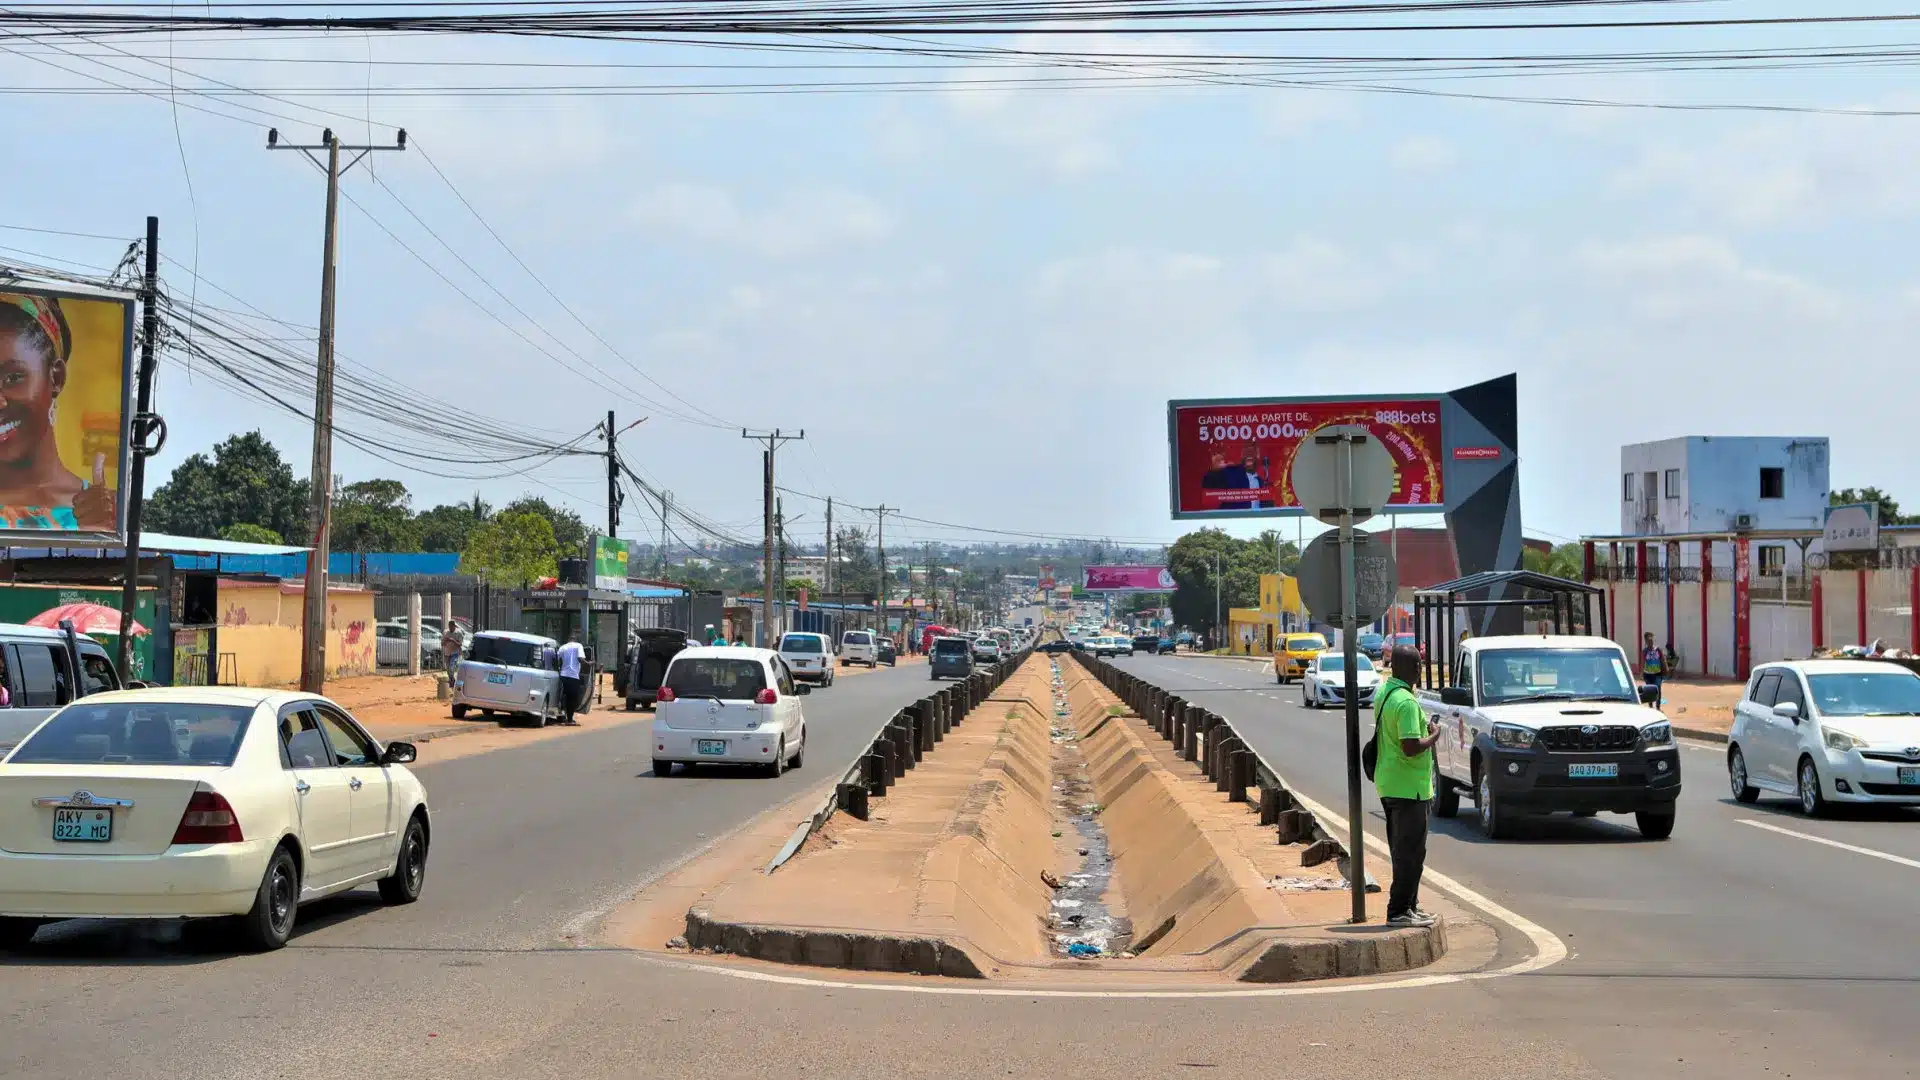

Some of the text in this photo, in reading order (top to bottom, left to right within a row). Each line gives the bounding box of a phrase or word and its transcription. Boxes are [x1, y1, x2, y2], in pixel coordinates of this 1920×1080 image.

[1198, 415, 1233, 425] GANHE
[1236, 414, 1259, 424] UMA
[1261, 412, 1293, 422] PARTE
[1376, 410, 1436, 424] 888bets
[1570, 765, 1584, 775] AAQ
[1586, 765, 1600, 775] 379
[58, 811, 83, 823] AKY
[57, 825, 107, 838] 822 MC
